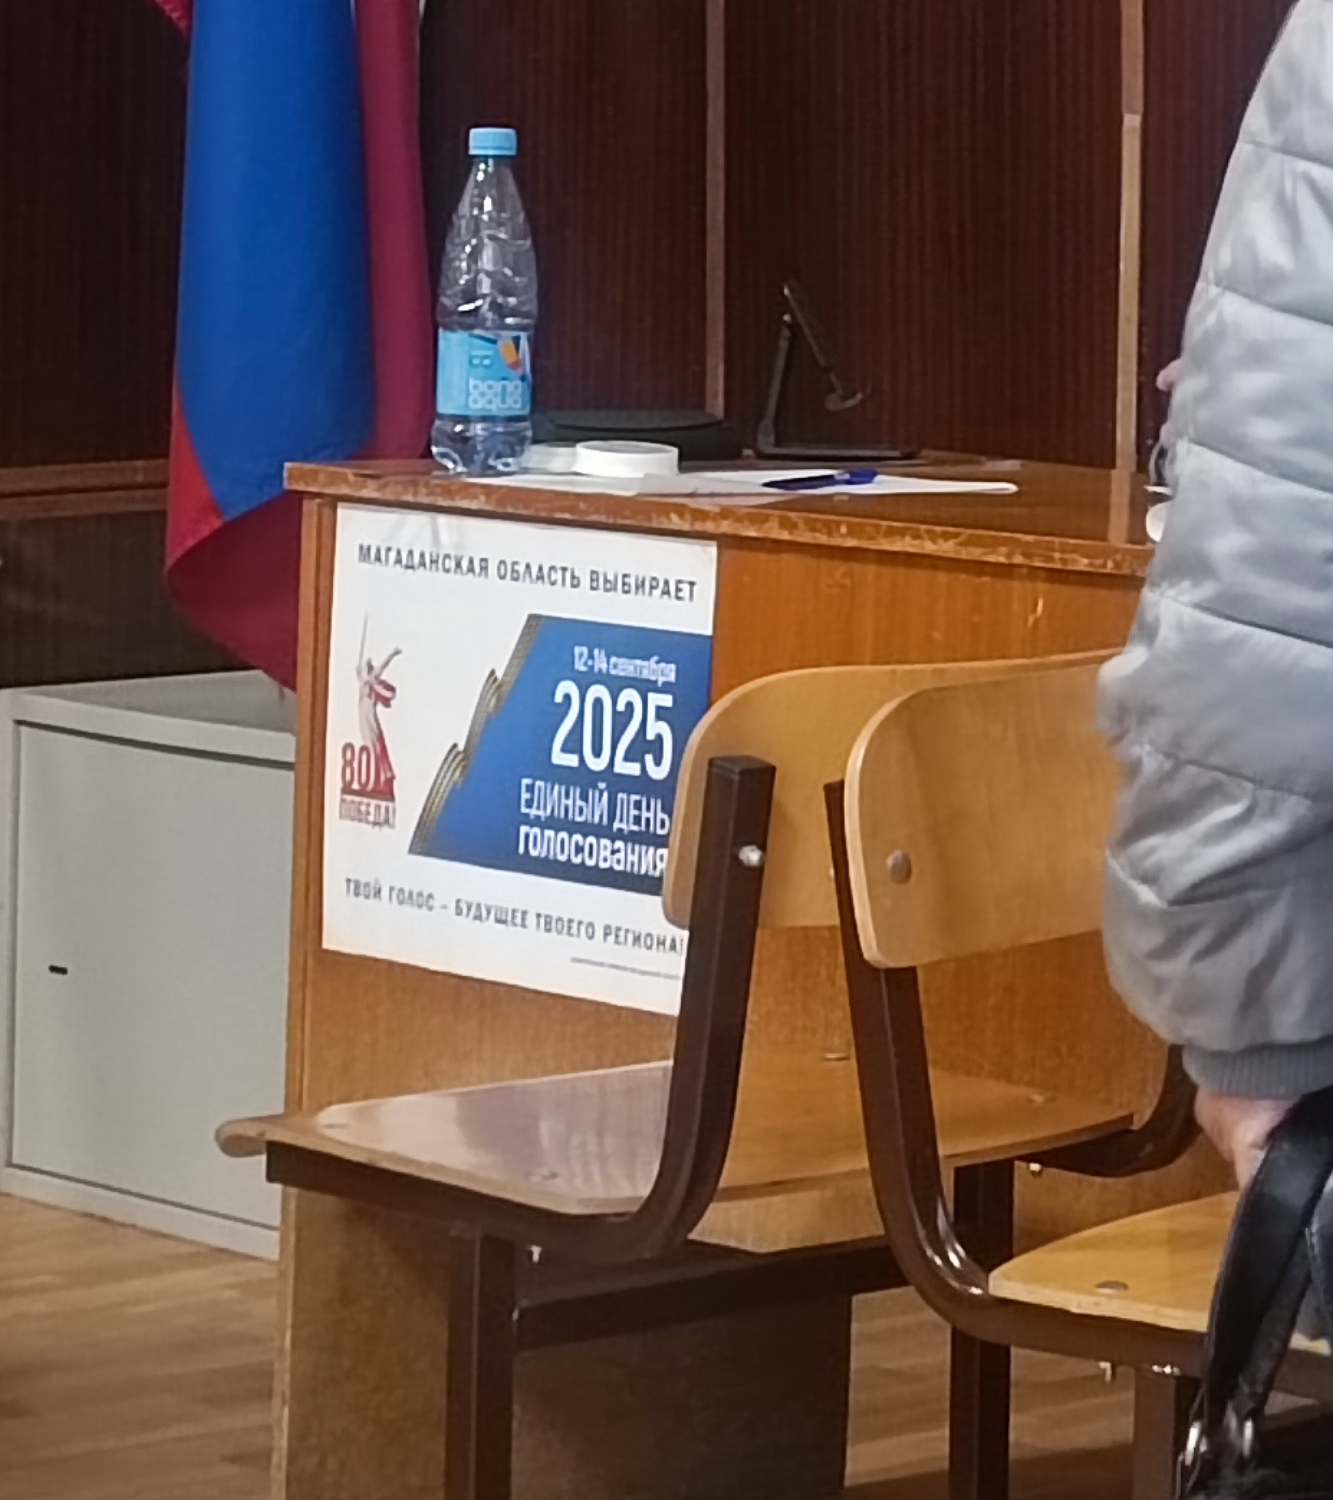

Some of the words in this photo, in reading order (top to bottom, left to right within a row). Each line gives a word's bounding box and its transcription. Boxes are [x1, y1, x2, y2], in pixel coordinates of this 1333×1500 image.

[358, 543, 490, 578] МАГАДАНСКАЯ
[497, 560, 581, 590] ОБЛАСТЬ
[590, 572, 697, 603] ВЫБИРАЕТ
[574, 646, 608, 674] 12-14
[551, 680, 674, 781] 2025
[341, 741, 371, 790] 80
[520, 778, 608, 826] ЕДИНЫЙ
[613, 792, 670, 835] ДЕНЬ
[518, 825, 669, 877] голосования
[345, 877, 382, 900] ТВОЙ
[388, 886, 435, 911] ГОЛОС
[455, 898, 529, 929] БУДУЩЕЕ
[535, 912, 596, 941] ТВОЕГО
[603, 925, 684, 955] РЕГИОНА!
